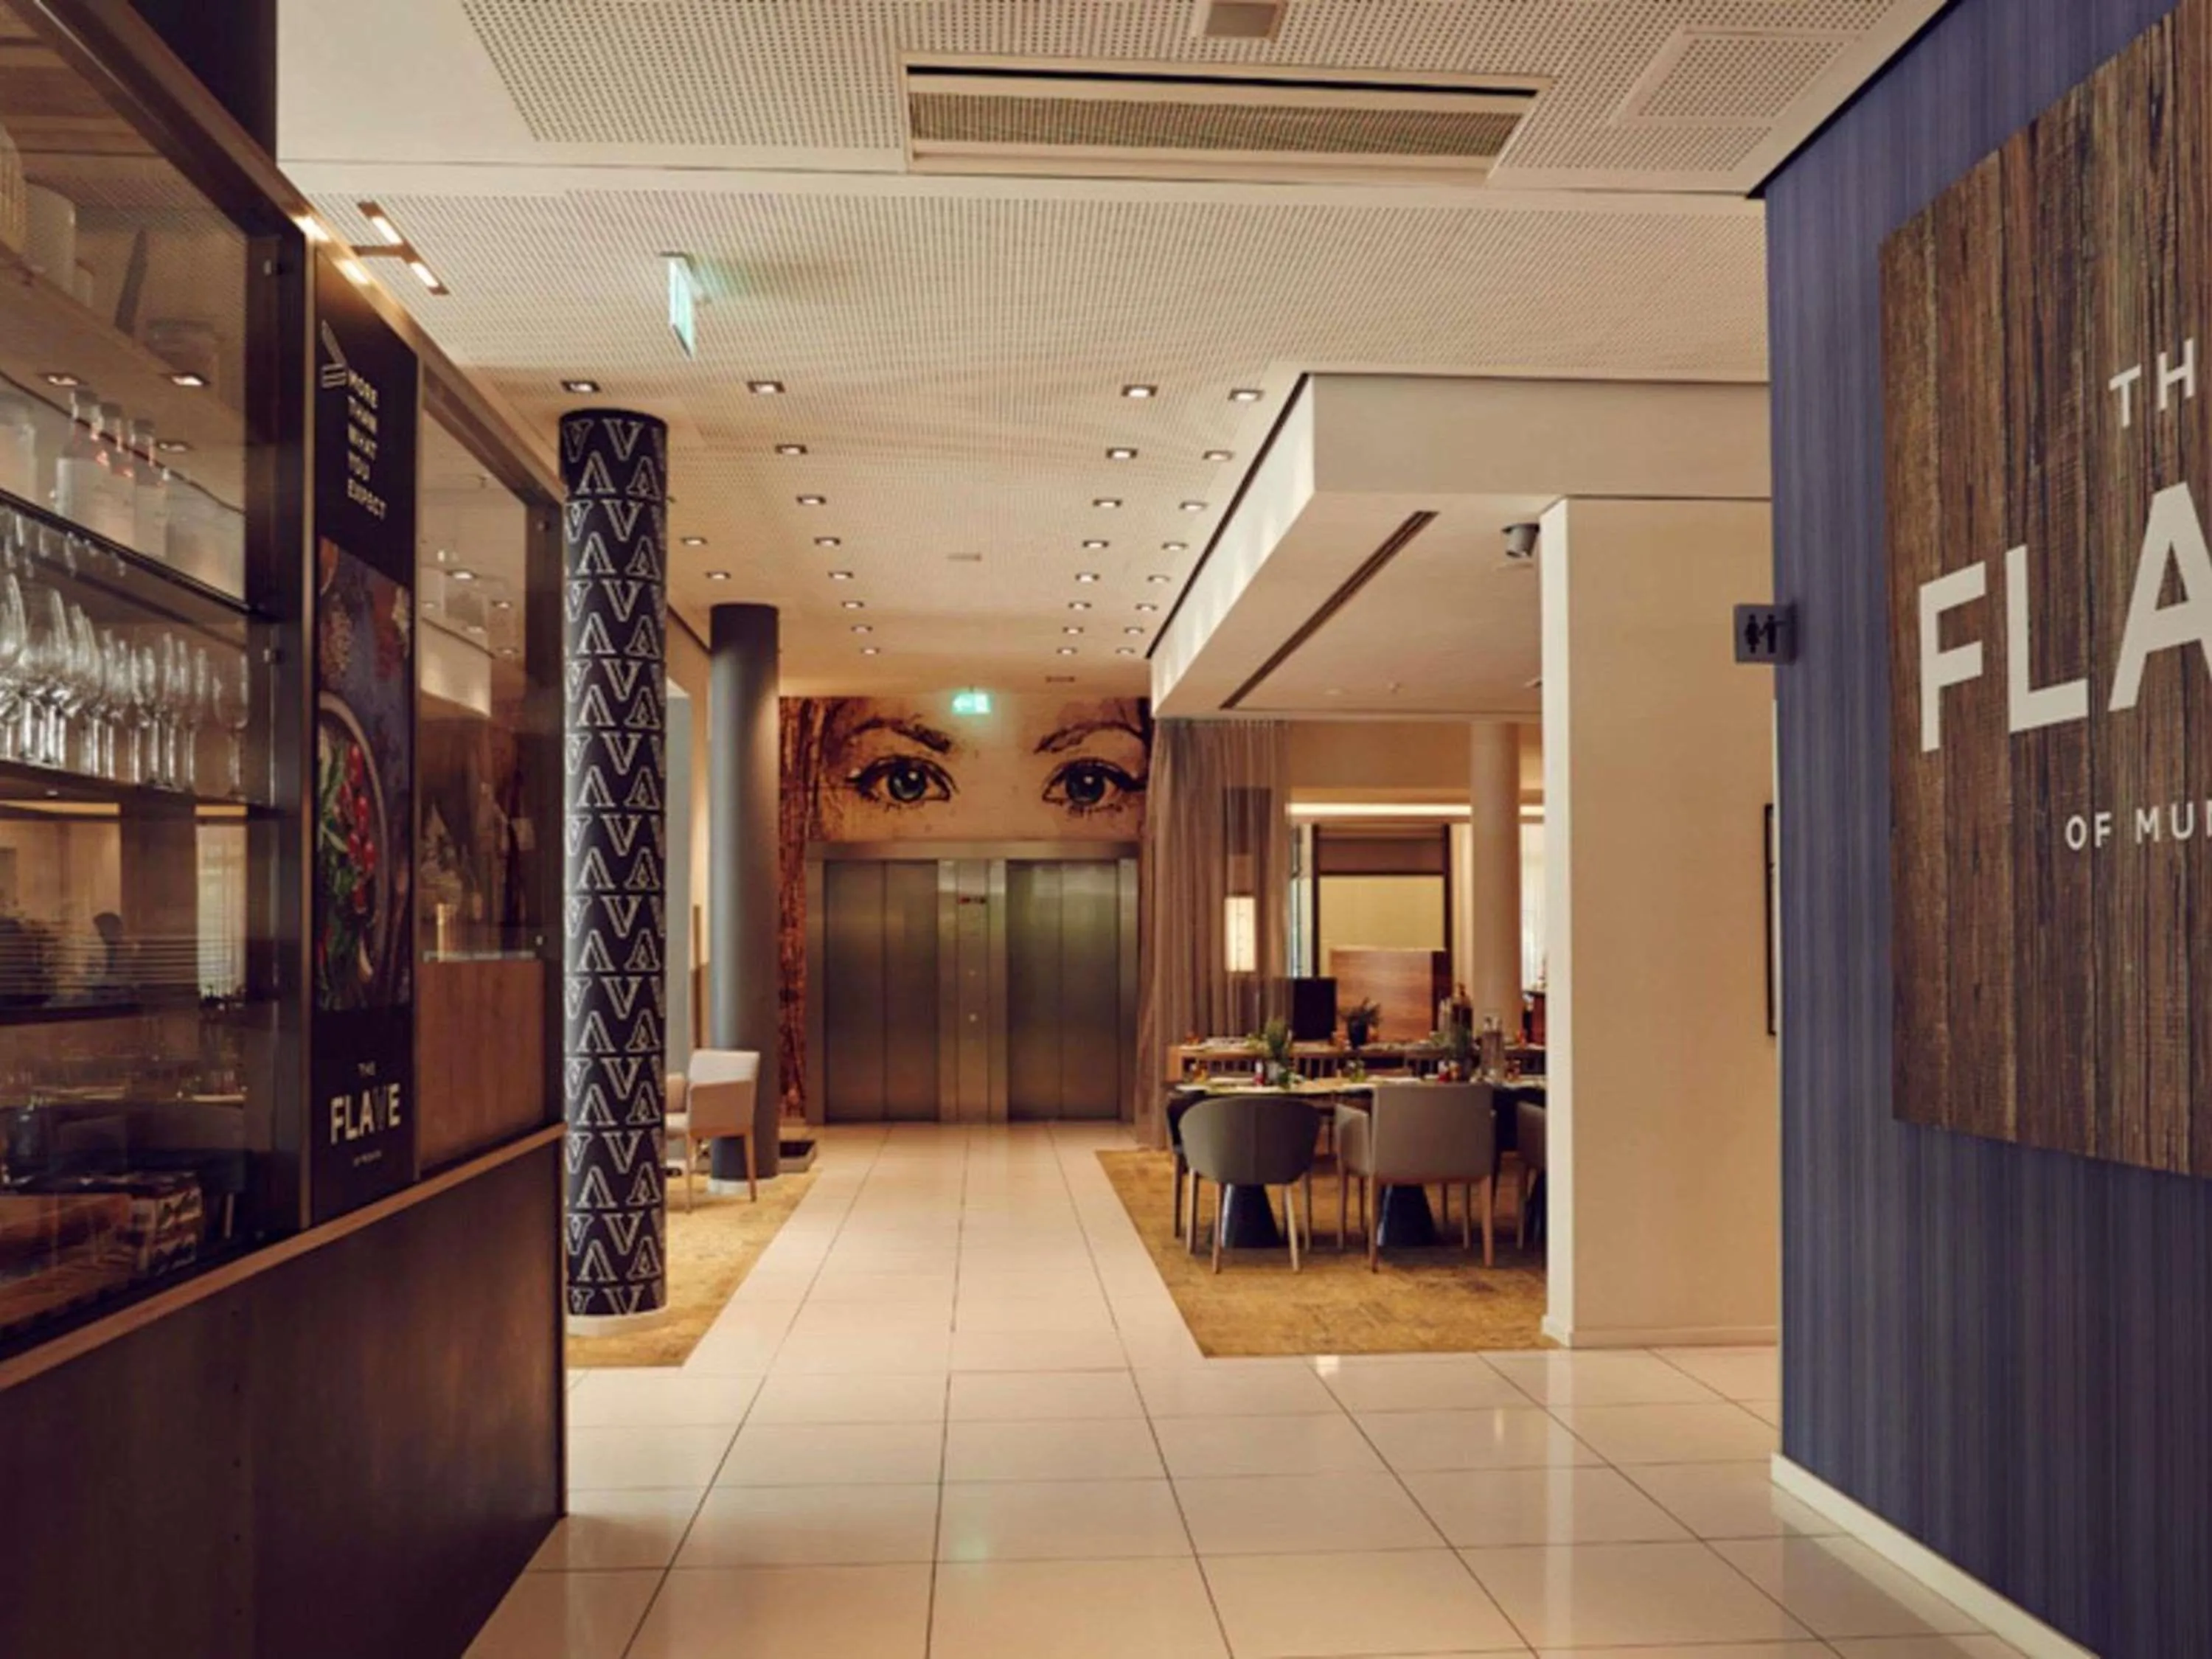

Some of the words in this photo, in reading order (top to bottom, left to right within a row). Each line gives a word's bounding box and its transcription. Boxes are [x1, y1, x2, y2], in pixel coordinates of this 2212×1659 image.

[347, 450, 370, 481] YOU
[347, 478, 387, 519] EXPECT
[2065, 812, 2112, 851] OF
[2135, 799, 2212, 845] MU
